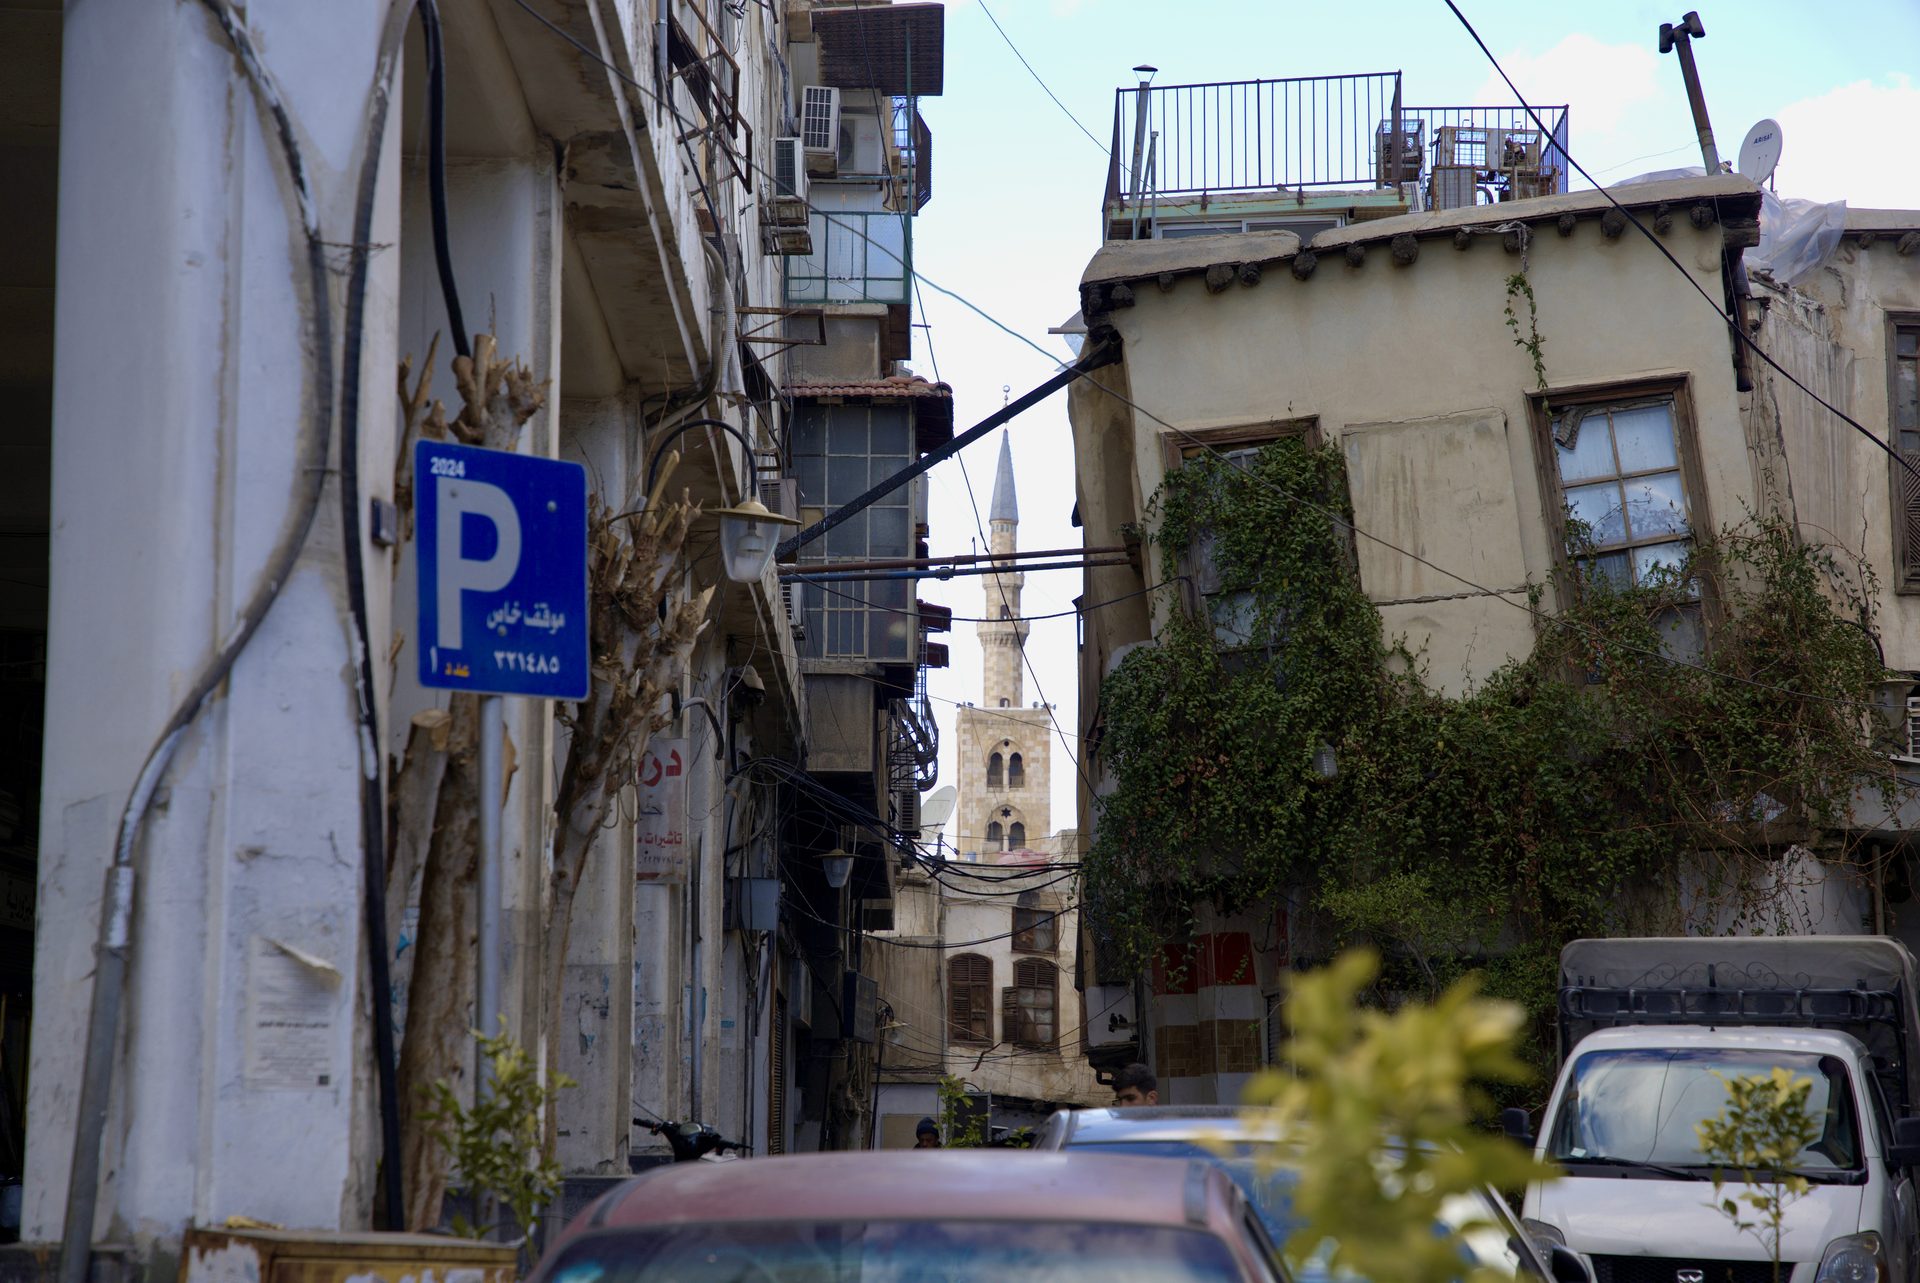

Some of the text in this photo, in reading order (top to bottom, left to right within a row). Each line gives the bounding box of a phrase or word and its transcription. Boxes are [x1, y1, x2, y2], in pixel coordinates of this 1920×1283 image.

[430, 457, 466, 478] 2024
[436, 476, 523, 651] P
[486, 600, 565, 635] موقف خاص
